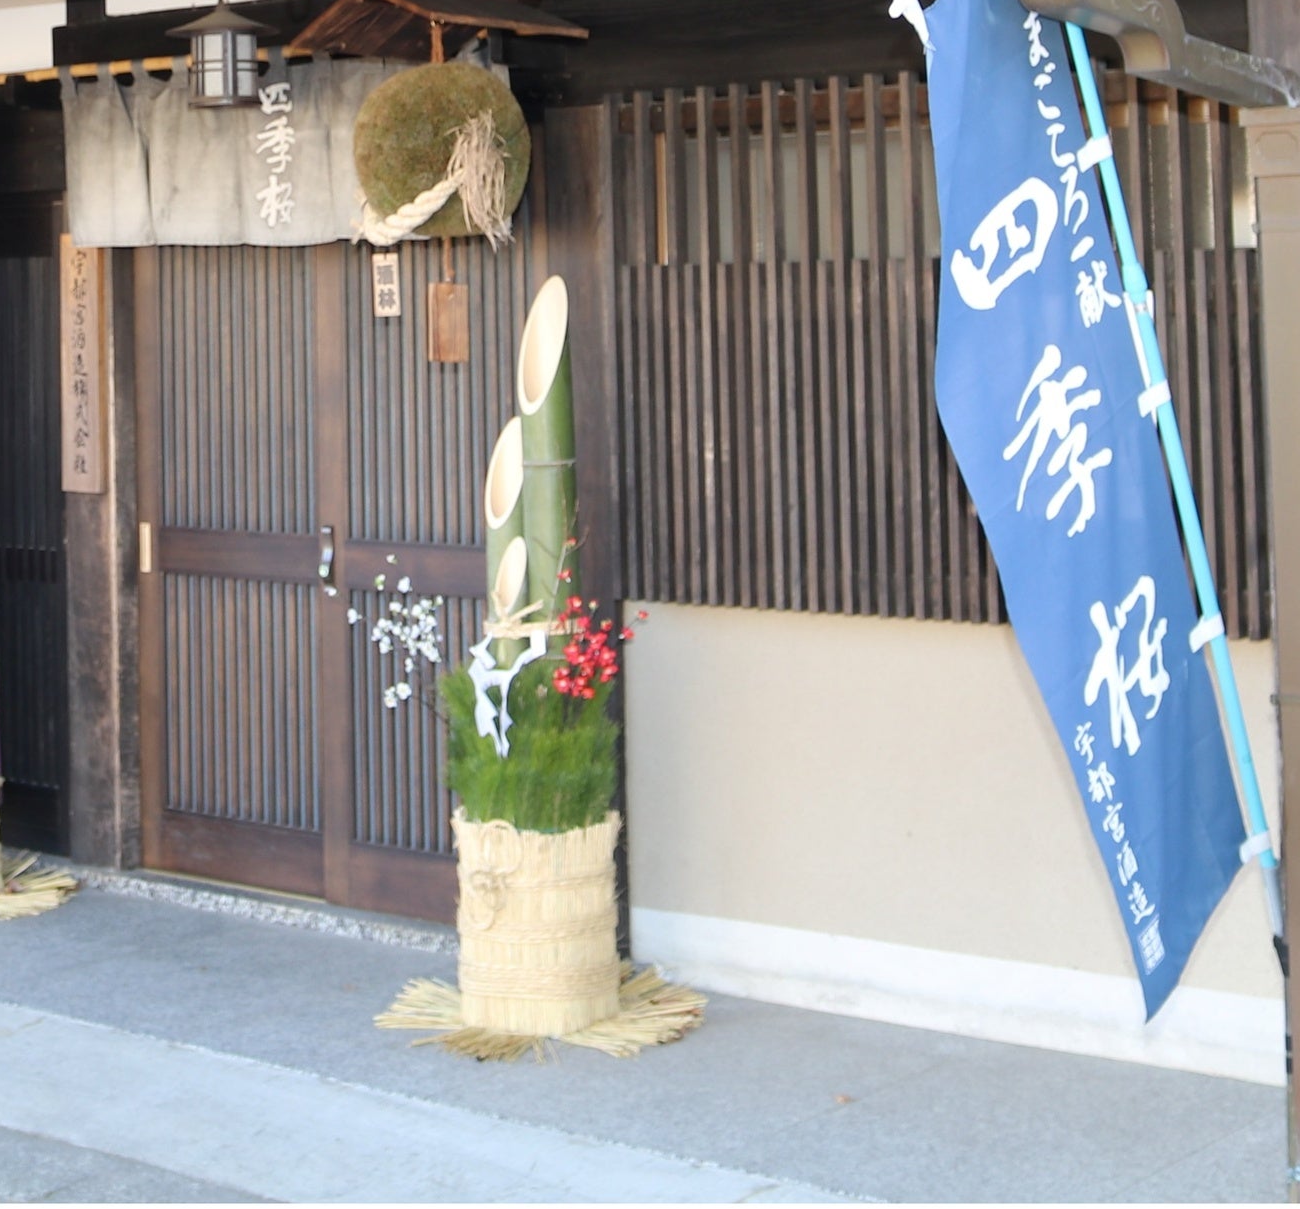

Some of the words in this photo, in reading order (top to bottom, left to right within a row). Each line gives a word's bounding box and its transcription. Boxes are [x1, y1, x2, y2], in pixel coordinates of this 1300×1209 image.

[256, 82, 296, 229] 四季桜
[950, 176, 1171, 757] 四季桜
[1074, 721, 1156, 925] 宇都宮酒造
